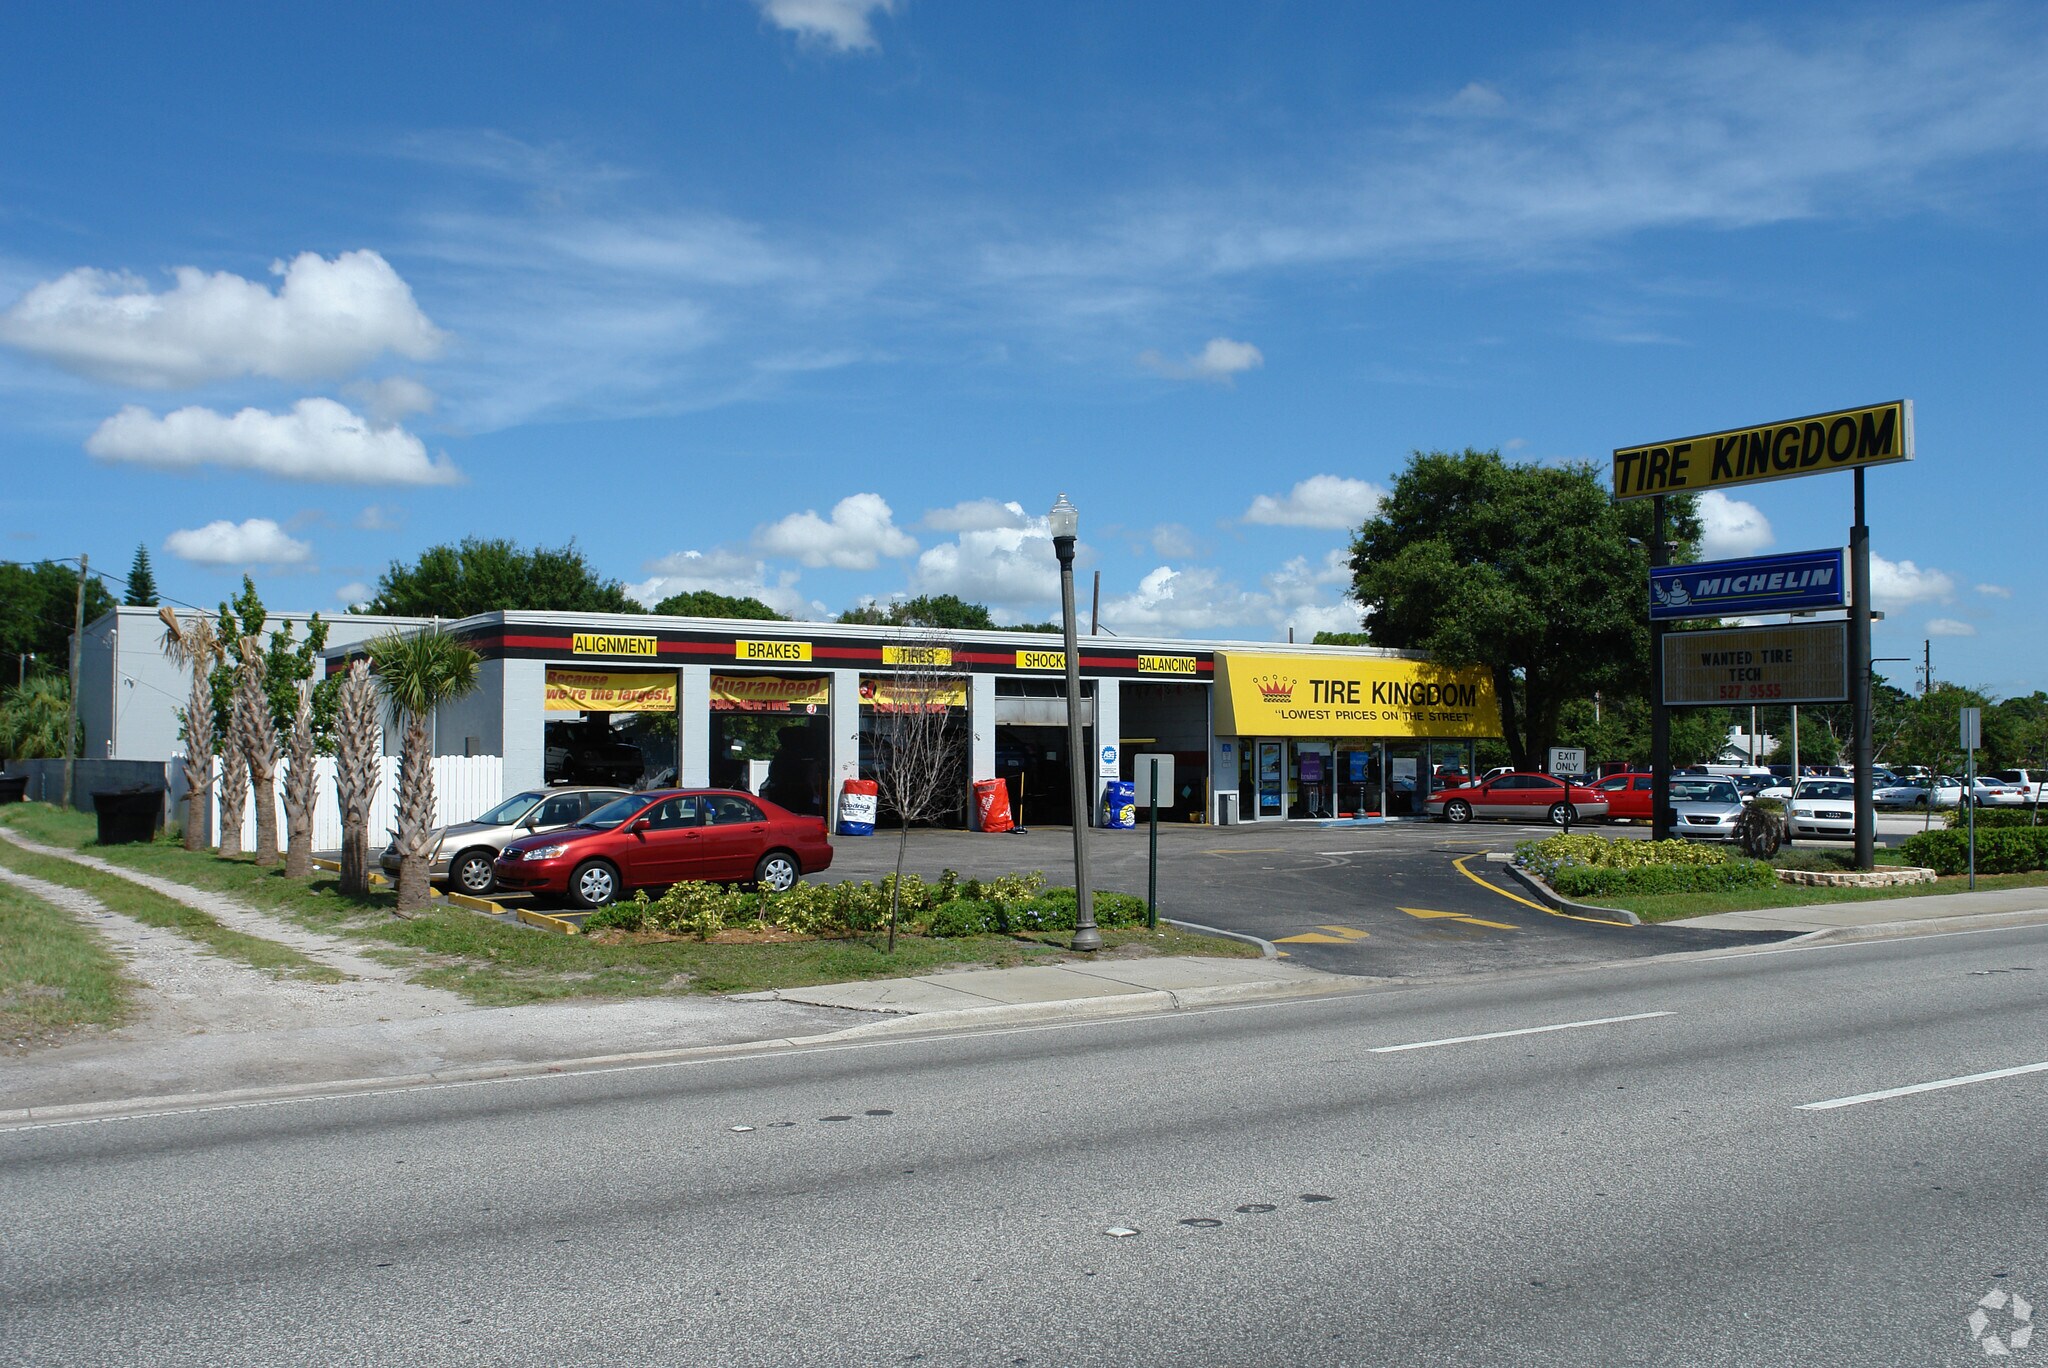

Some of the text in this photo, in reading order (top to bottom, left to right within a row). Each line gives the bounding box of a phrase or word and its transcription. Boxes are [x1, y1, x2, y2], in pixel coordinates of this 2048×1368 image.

[1616, 408, 1897, 493] TIRE KINGDOM
[1696, 568, 1834, 596] MICHELIN
[574, 636, 655, 654] ALIGNMENT
[748, 643, 800, 659] BRAKES
[900, 648, 935, 664] TIRES
[1701, 649, 1793, 666] WANTED TIRE
[1139, 658, 1196, 672] BALANCING
[547, 671, 608, 686] Because
[1729, 668, 1761, 681] TECH
[546, 687, 672, 703] we're the largest,
[1309, 679, 1476, 707] TIRE KINGDOM
[1719, 683, 1782, 699] 527 9555
[1336, 710, 1377, 720] PRICES
[1382, 711, 1399, 721] ON
[1402, 711, 1424, 721] THE
[1558, 752, 1576, 760] EXIT
[1556, 762, 1578, 771] ONLY
